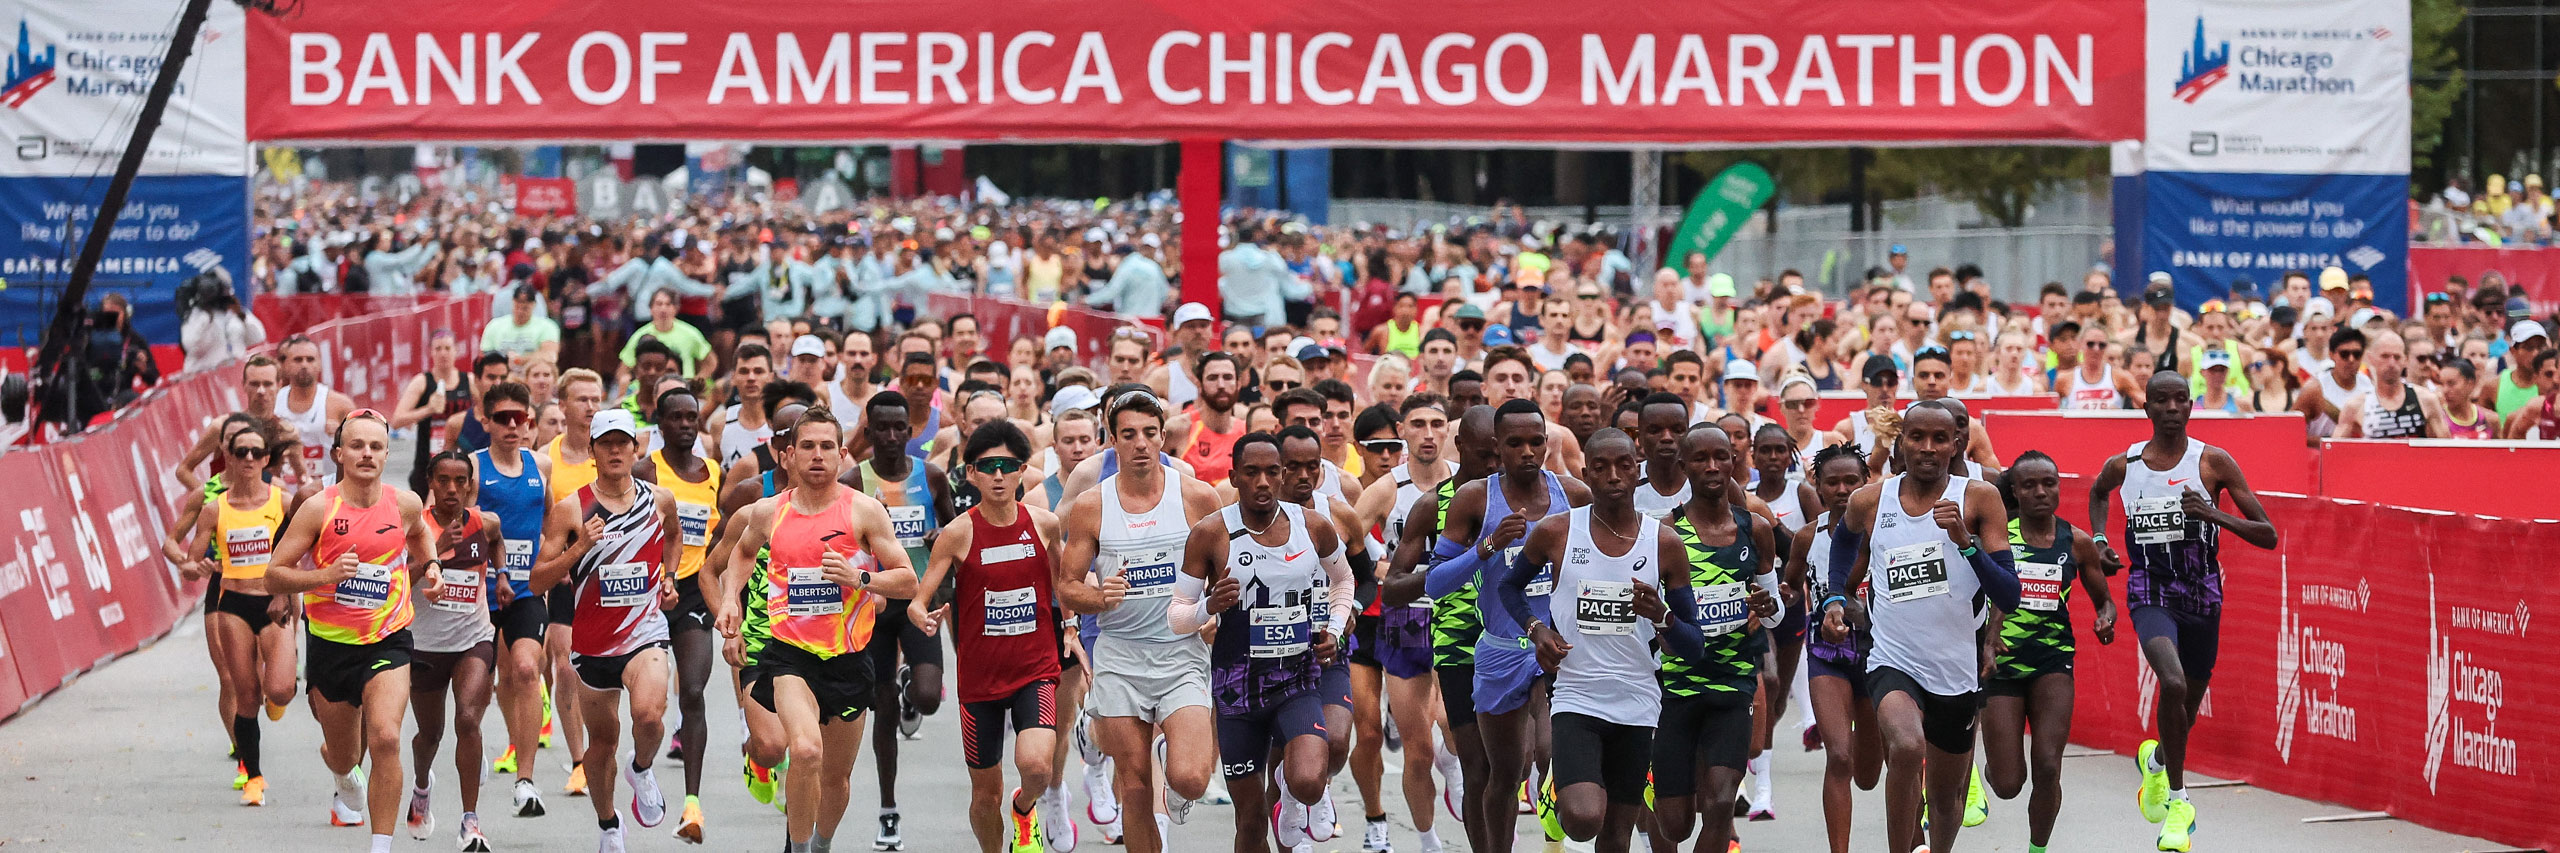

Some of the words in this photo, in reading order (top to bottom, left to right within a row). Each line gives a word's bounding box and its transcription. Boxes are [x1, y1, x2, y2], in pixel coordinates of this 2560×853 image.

[67, 51, 164, 74] Chicago
[2240, 45, 2334, 71] Chicago
[289, 31, 542, 106] BANK
[566, 31, 689, 106] OF
[706, 31, 1123, 106] AMERICA
[1146, 31, 1549, 107] CHICAGO
[1580, 33, 2094, 107] MARATHON
[67, 76, 185, 97] Marathn
[2240, 73, 2355, 94] Marathon
[149, 203, 180, 224] you
[2211, 198, 2256, 217] What
[2260, 199, 2310, 216] would
[2312, 201, 2345, 222] you
[21, 222, 50, 242] like
[146, 225, 165, 242] to
[168, 219, 200, 241] do?
[2188, 217, 2219, 237] like
[2221, 218, 2251, 238] the
[2252, 222, 2305, 241] power
[2309, 222, 2329, 239] to
[2331, 217, 2365, 239] do?
[3, 256, 58, 275] BANK
[2171, 250, 2225, 268] BANK
[2226, 251, 2253, 269] OF
[2255, 252, 2344, 270] AMERICA
[1127, 520, 1157, 529] saucony
[2134, 513, 2169, 528] PACE
[2172, 512, 2182, 525] 6
[228, 540, 270, 554] VAUGHN
[1123, 566, 1174, 581] SHRADER
[1888, 563, 1930, 584] PACE
[1933, 561, 1942, 575] 1
[339, 579, 388, 594] PANNING
[604, 577, 645, 593] YASUI
[789, 586, 840, 597] ALBERTSON
[2021, 583, 2060, 594] PKOSGEI
[1579, 600, 1622, 617] PACE
[1626, 603, 1636, 617] 2
[2301, 584, 2320, 605] BANK
[2320, 584, 2329, 605] OF
[2329, 586, 2358, 612] AMERICA
[986, 605, 1035, 619] HOSOYA
[1697, 600, 1743, 620] KORIR
[2451, 606, 2471, 628] BANK
[2471, 608, 2481, 630] OF
[2481, 610, 2515, 636] AMERICA
[1264, 625, 1296, 641] ESA
[2302, 625, 2346, 690] Chicago
[2453, 650, 2503, 722] Chicago
[2304, 688, 2357, 742] Marathon
[2453, 716, 2517, 776] Marathon
